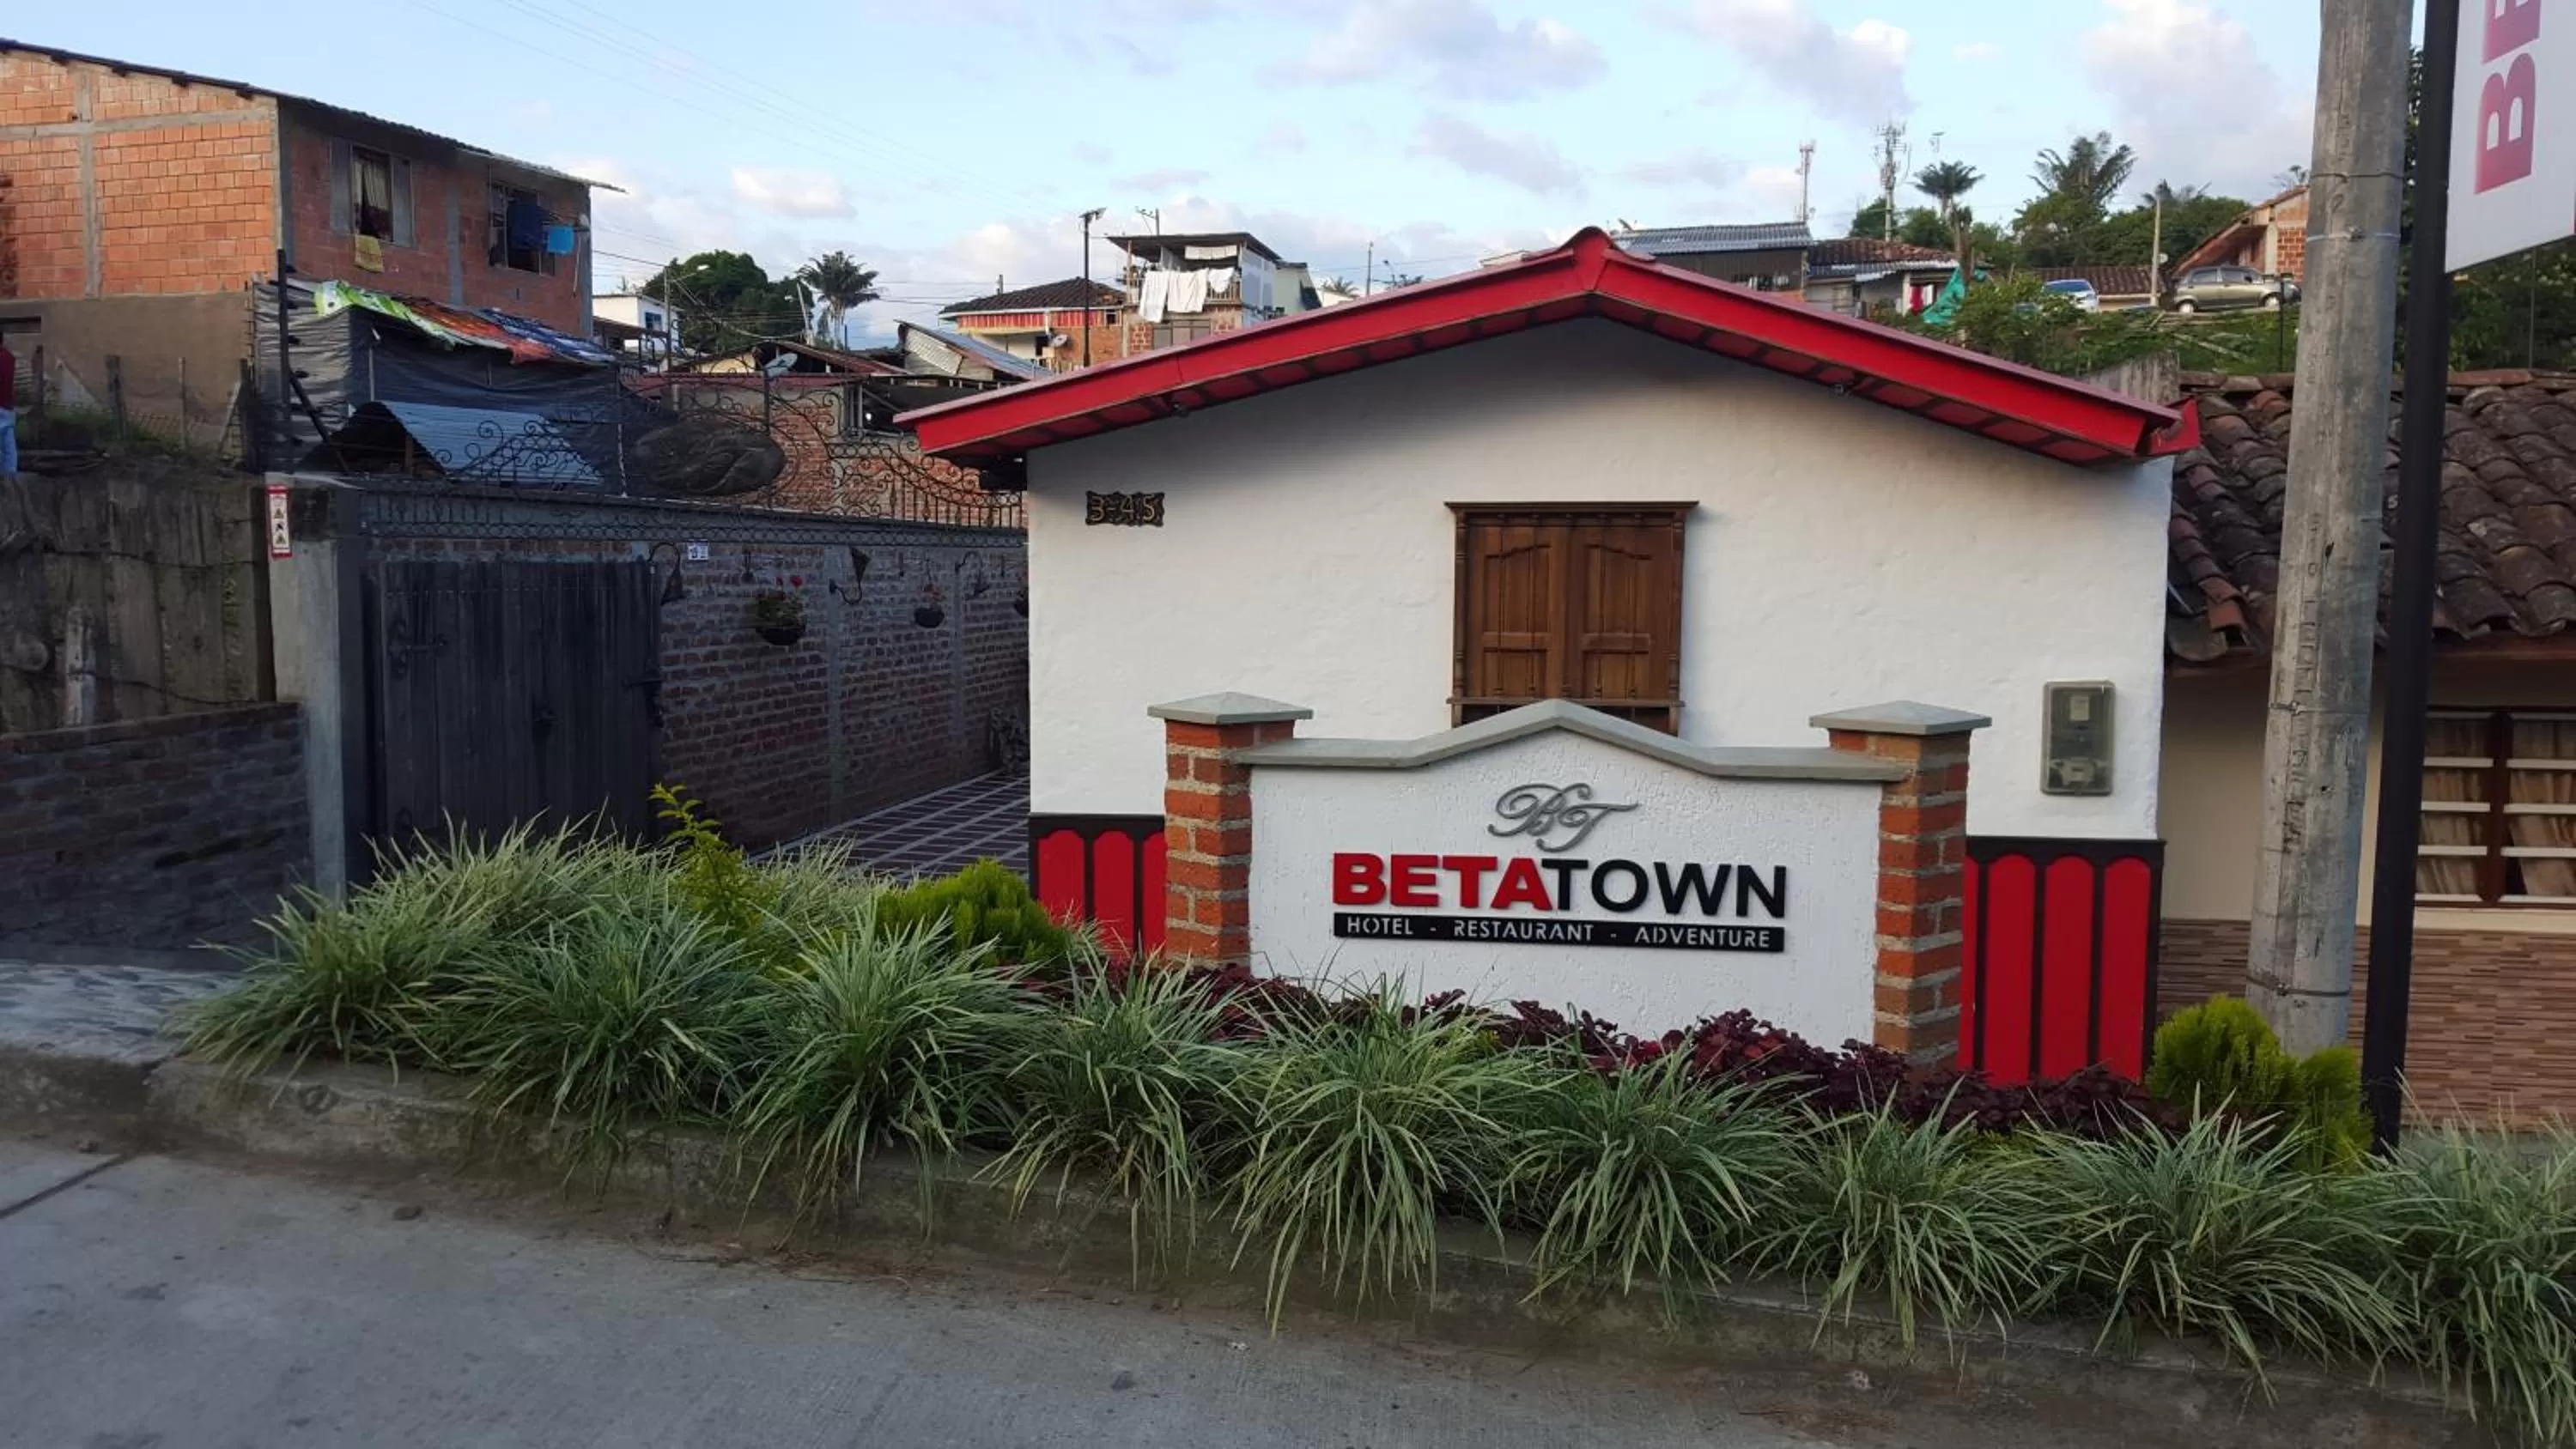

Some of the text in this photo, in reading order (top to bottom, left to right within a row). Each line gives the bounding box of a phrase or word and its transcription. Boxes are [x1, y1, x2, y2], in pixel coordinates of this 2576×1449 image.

[1333, 852, 1786, 919] BETATOWN
[1346, 916, 1414, 936] HOTEL
[1454, 919, 1594, 942] RESTAURANT
[1635, 926, 1771, 949] ADVENTURE
